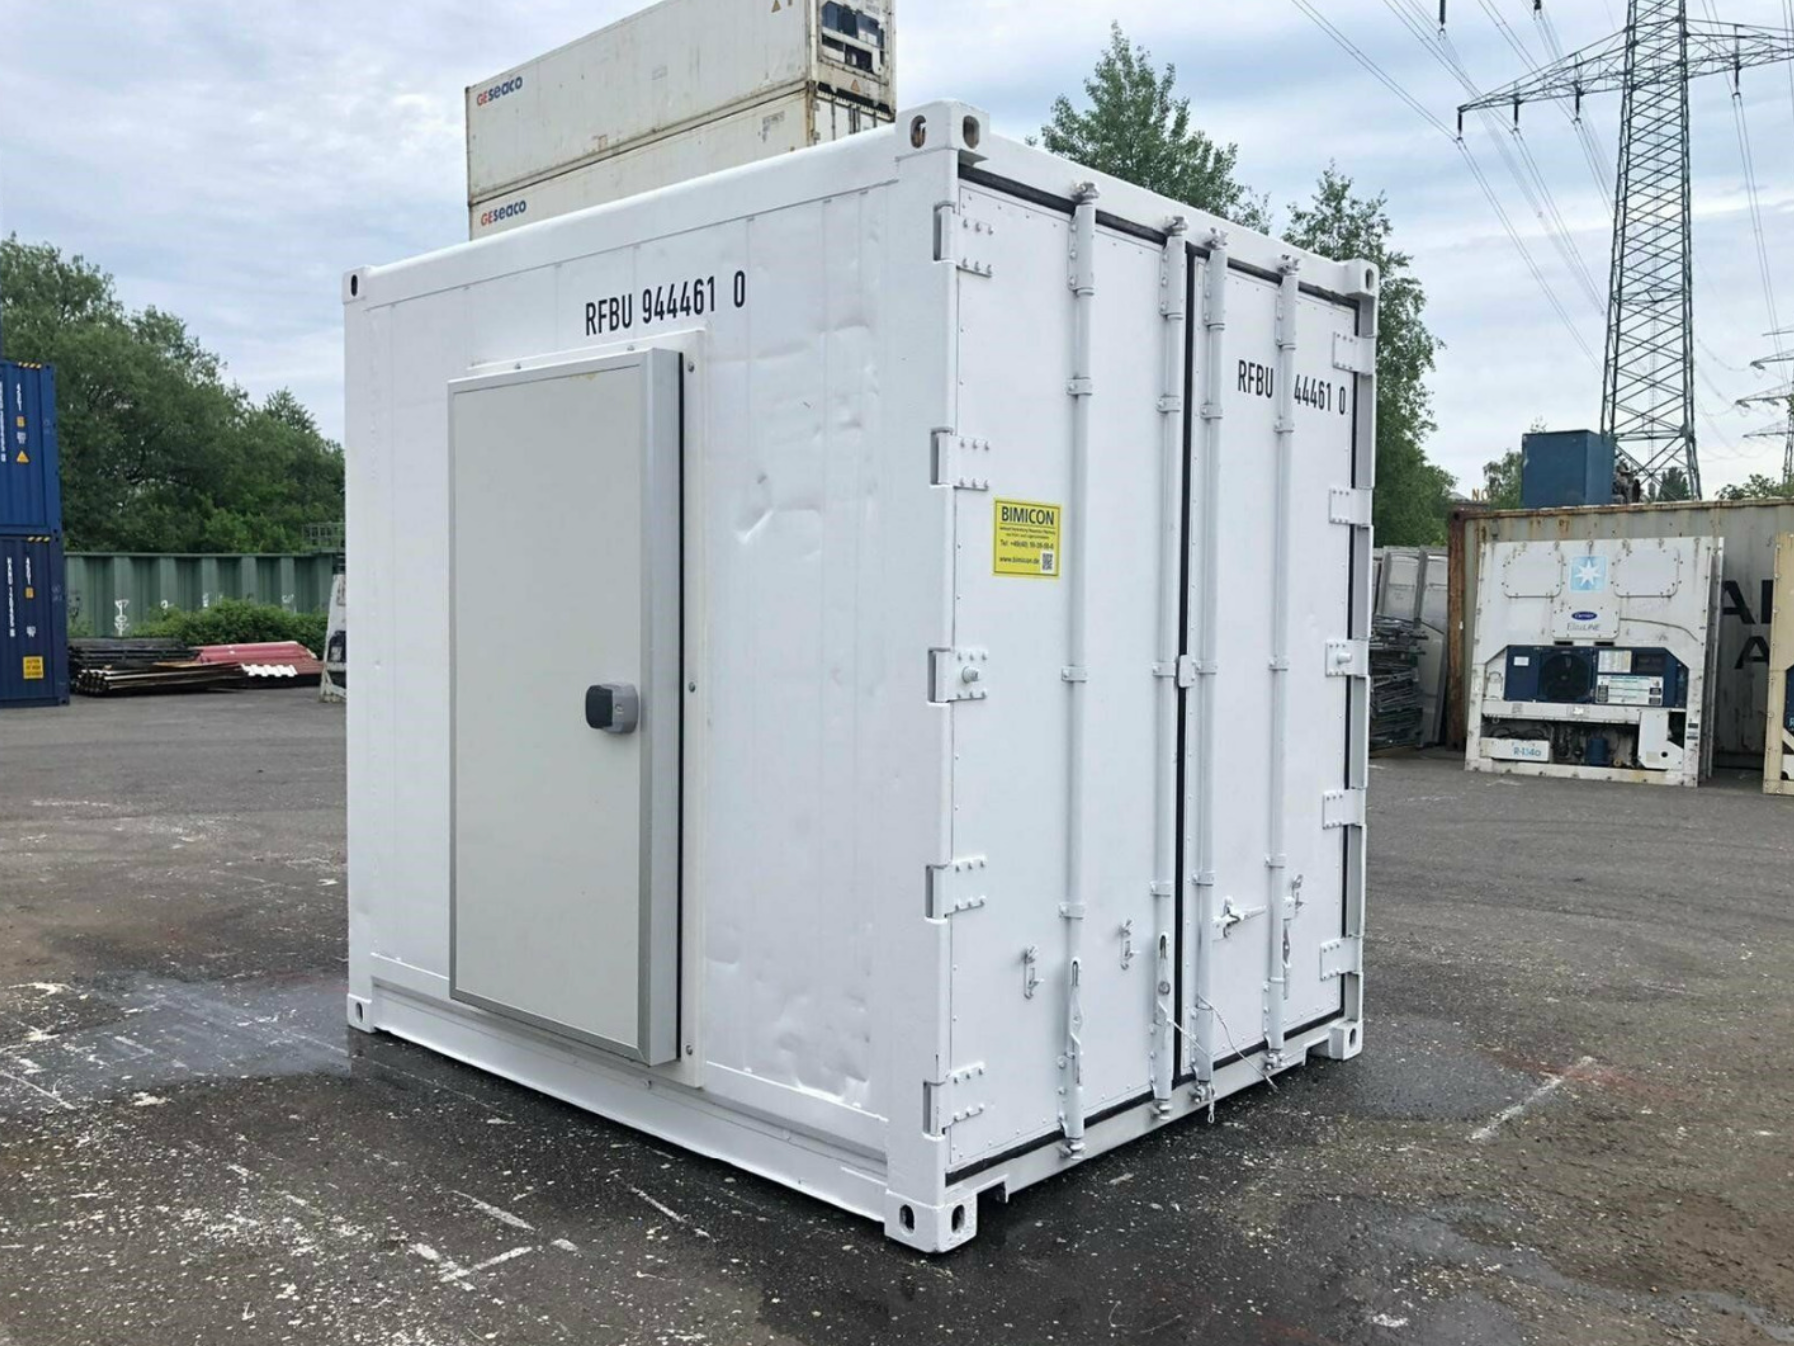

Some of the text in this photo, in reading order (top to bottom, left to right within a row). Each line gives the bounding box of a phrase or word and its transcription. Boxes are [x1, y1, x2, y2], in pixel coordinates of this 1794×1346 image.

[586, 270, 746, 336] RFBU 944461 0
[1238, 359, 1347, 416] RFBU 44461 0
[1001, 506, 1055, 526] BIMICON
